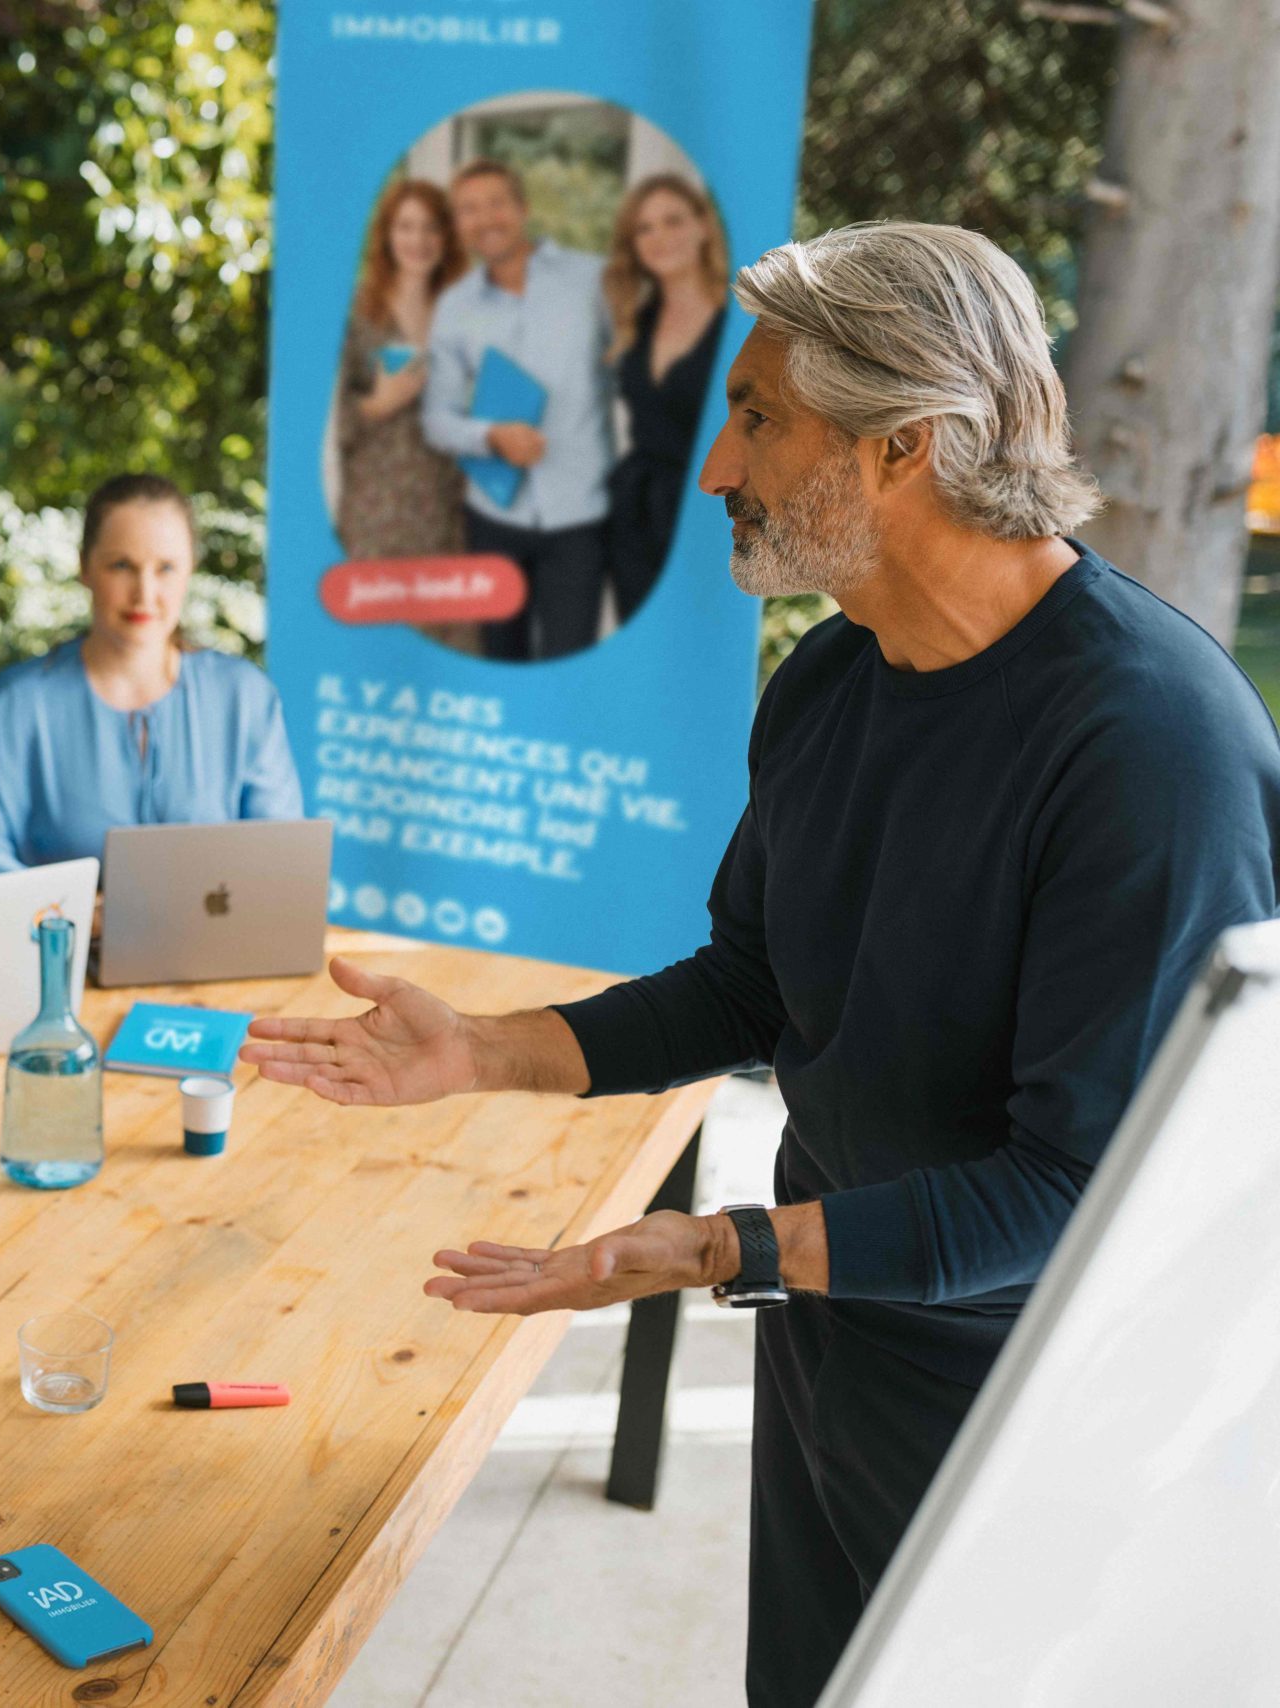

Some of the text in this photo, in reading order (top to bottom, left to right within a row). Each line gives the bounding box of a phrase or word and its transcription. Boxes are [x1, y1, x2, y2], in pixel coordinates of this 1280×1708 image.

[331, 14, 561, 44] IMMOBILIER
[317, 674, 502, 726] IL Y A DES
[317, 743, 524, 798] CHANGENT
[533, 778, 609, 816] UNE
[580, 749, 650, 787] QUI
[317, 775, 527, 834] REJOINDRE
[47, 1598, 98, 1618] IMMOBILIER
